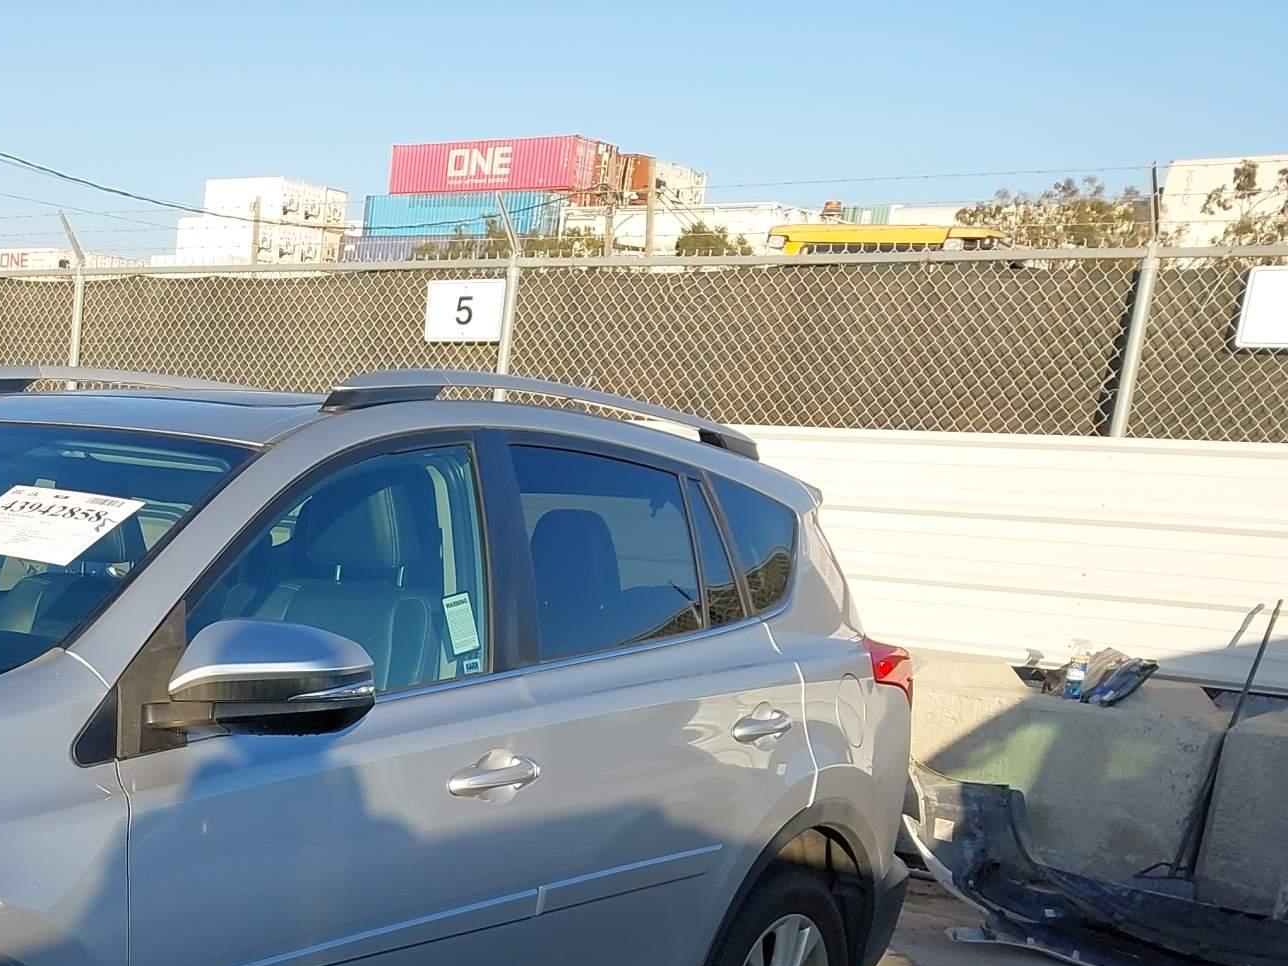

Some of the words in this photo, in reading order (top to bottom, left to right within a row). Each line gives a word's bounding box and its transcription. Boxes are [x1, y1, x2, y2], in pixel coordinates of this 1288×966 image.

[447, 147, 512, 177] ONE
[0, 253, 29, 268] ONE
[455, 295, 474, 325] 5
[0, 500, 108, 523] 43942858
